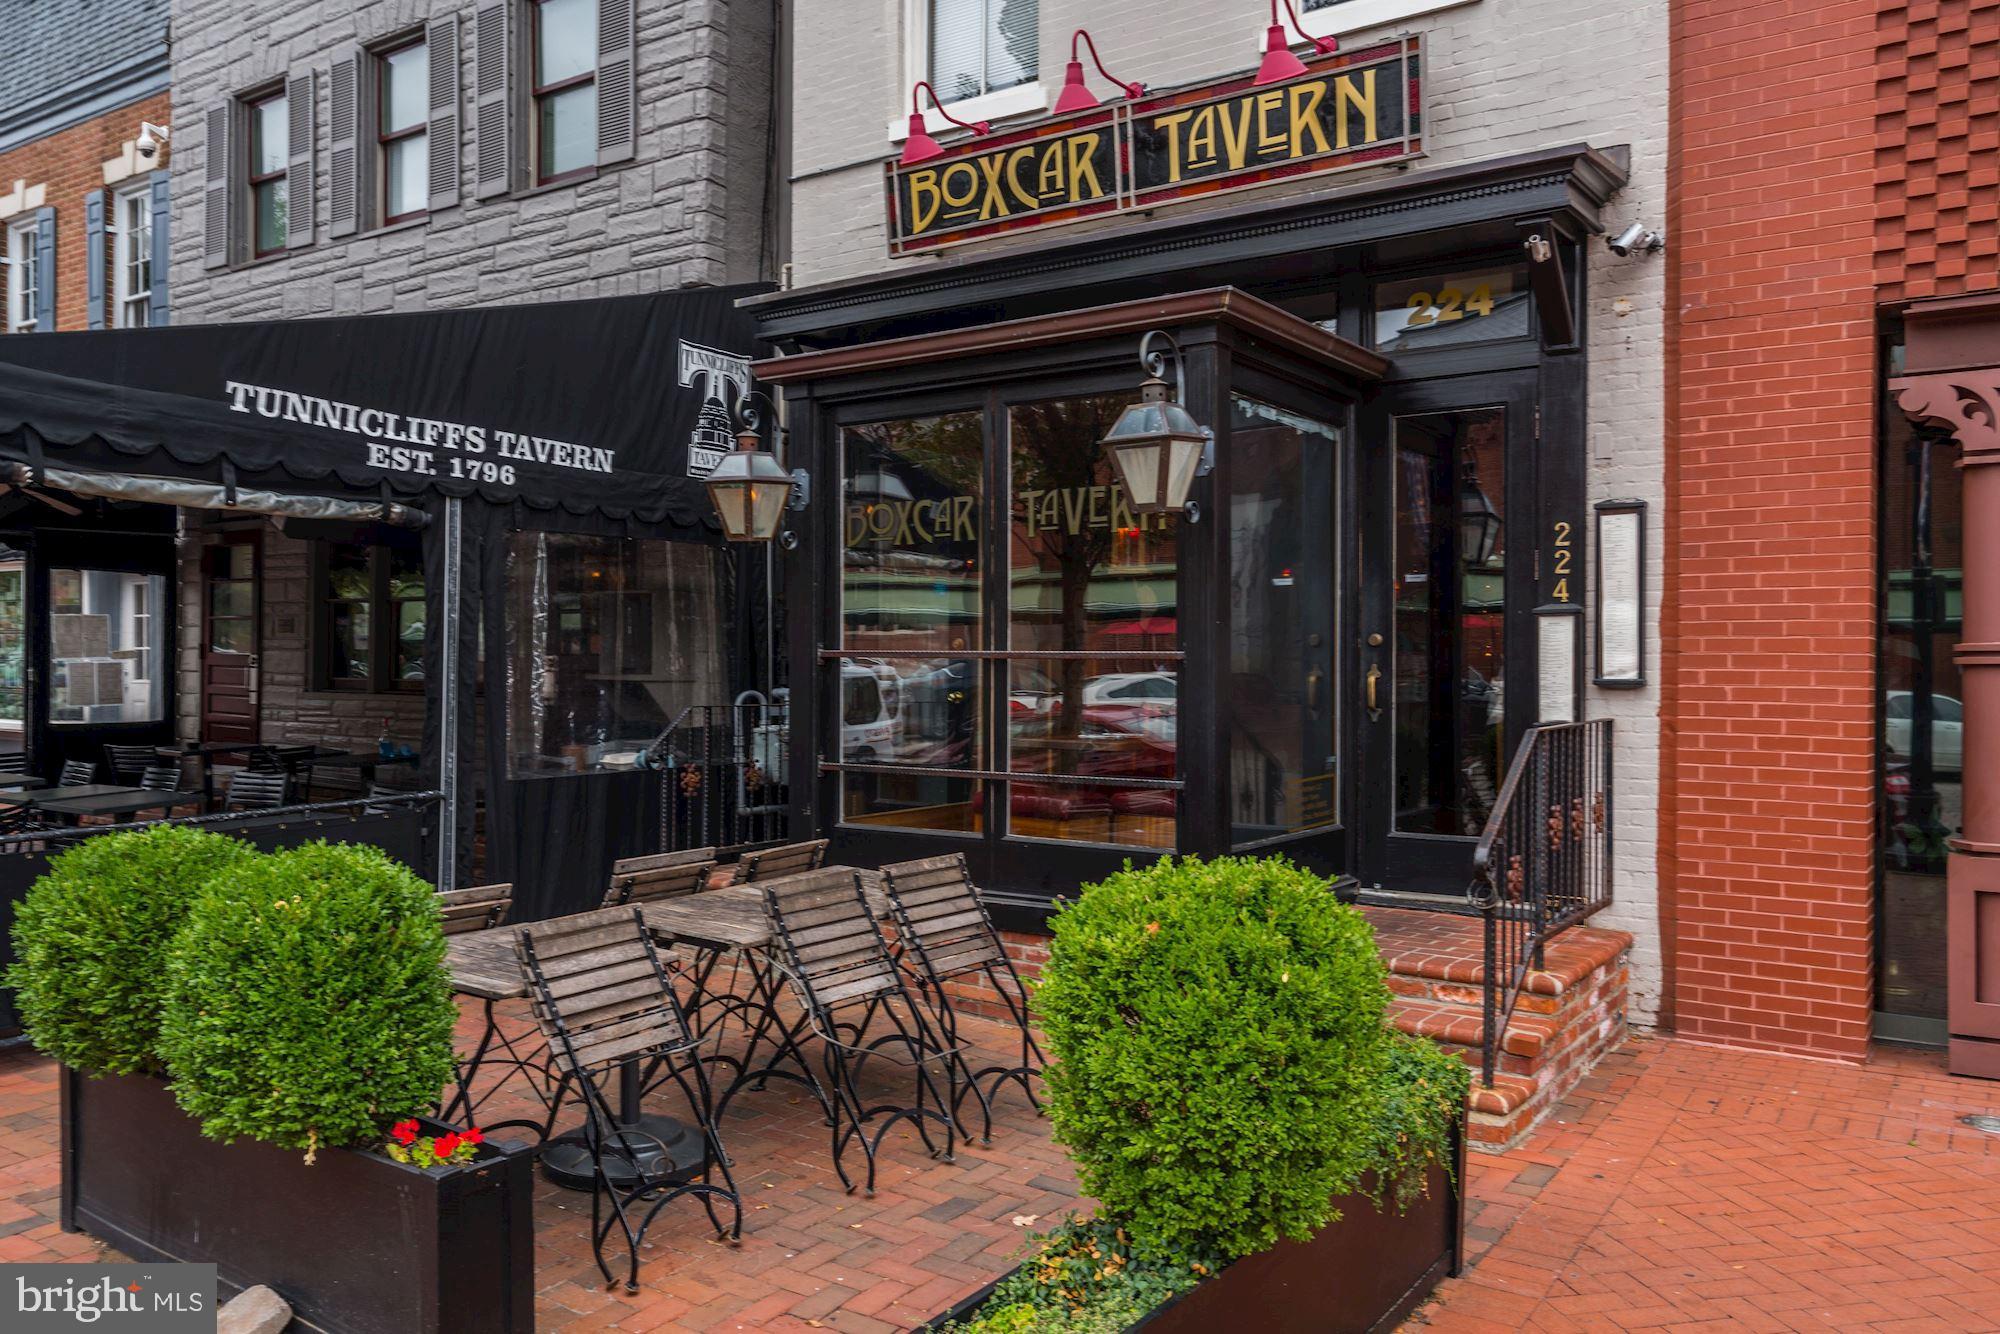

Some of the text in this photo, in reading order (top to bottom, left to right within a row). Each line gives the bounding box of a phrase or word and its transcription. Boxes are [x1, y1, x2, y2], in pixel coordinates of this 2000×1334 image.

[909, 69, 1378, 235] BOXCAR TAVERN
[1407, 284, 1494, 326] 224
[225, 380, 615, 474] TUNNICLIFFS TAVERN
[366, 443, 516, 487] EST. 1796
[845, 495, 977, 546] BOXCAR
[1552, 521, 1571, 603] 224
